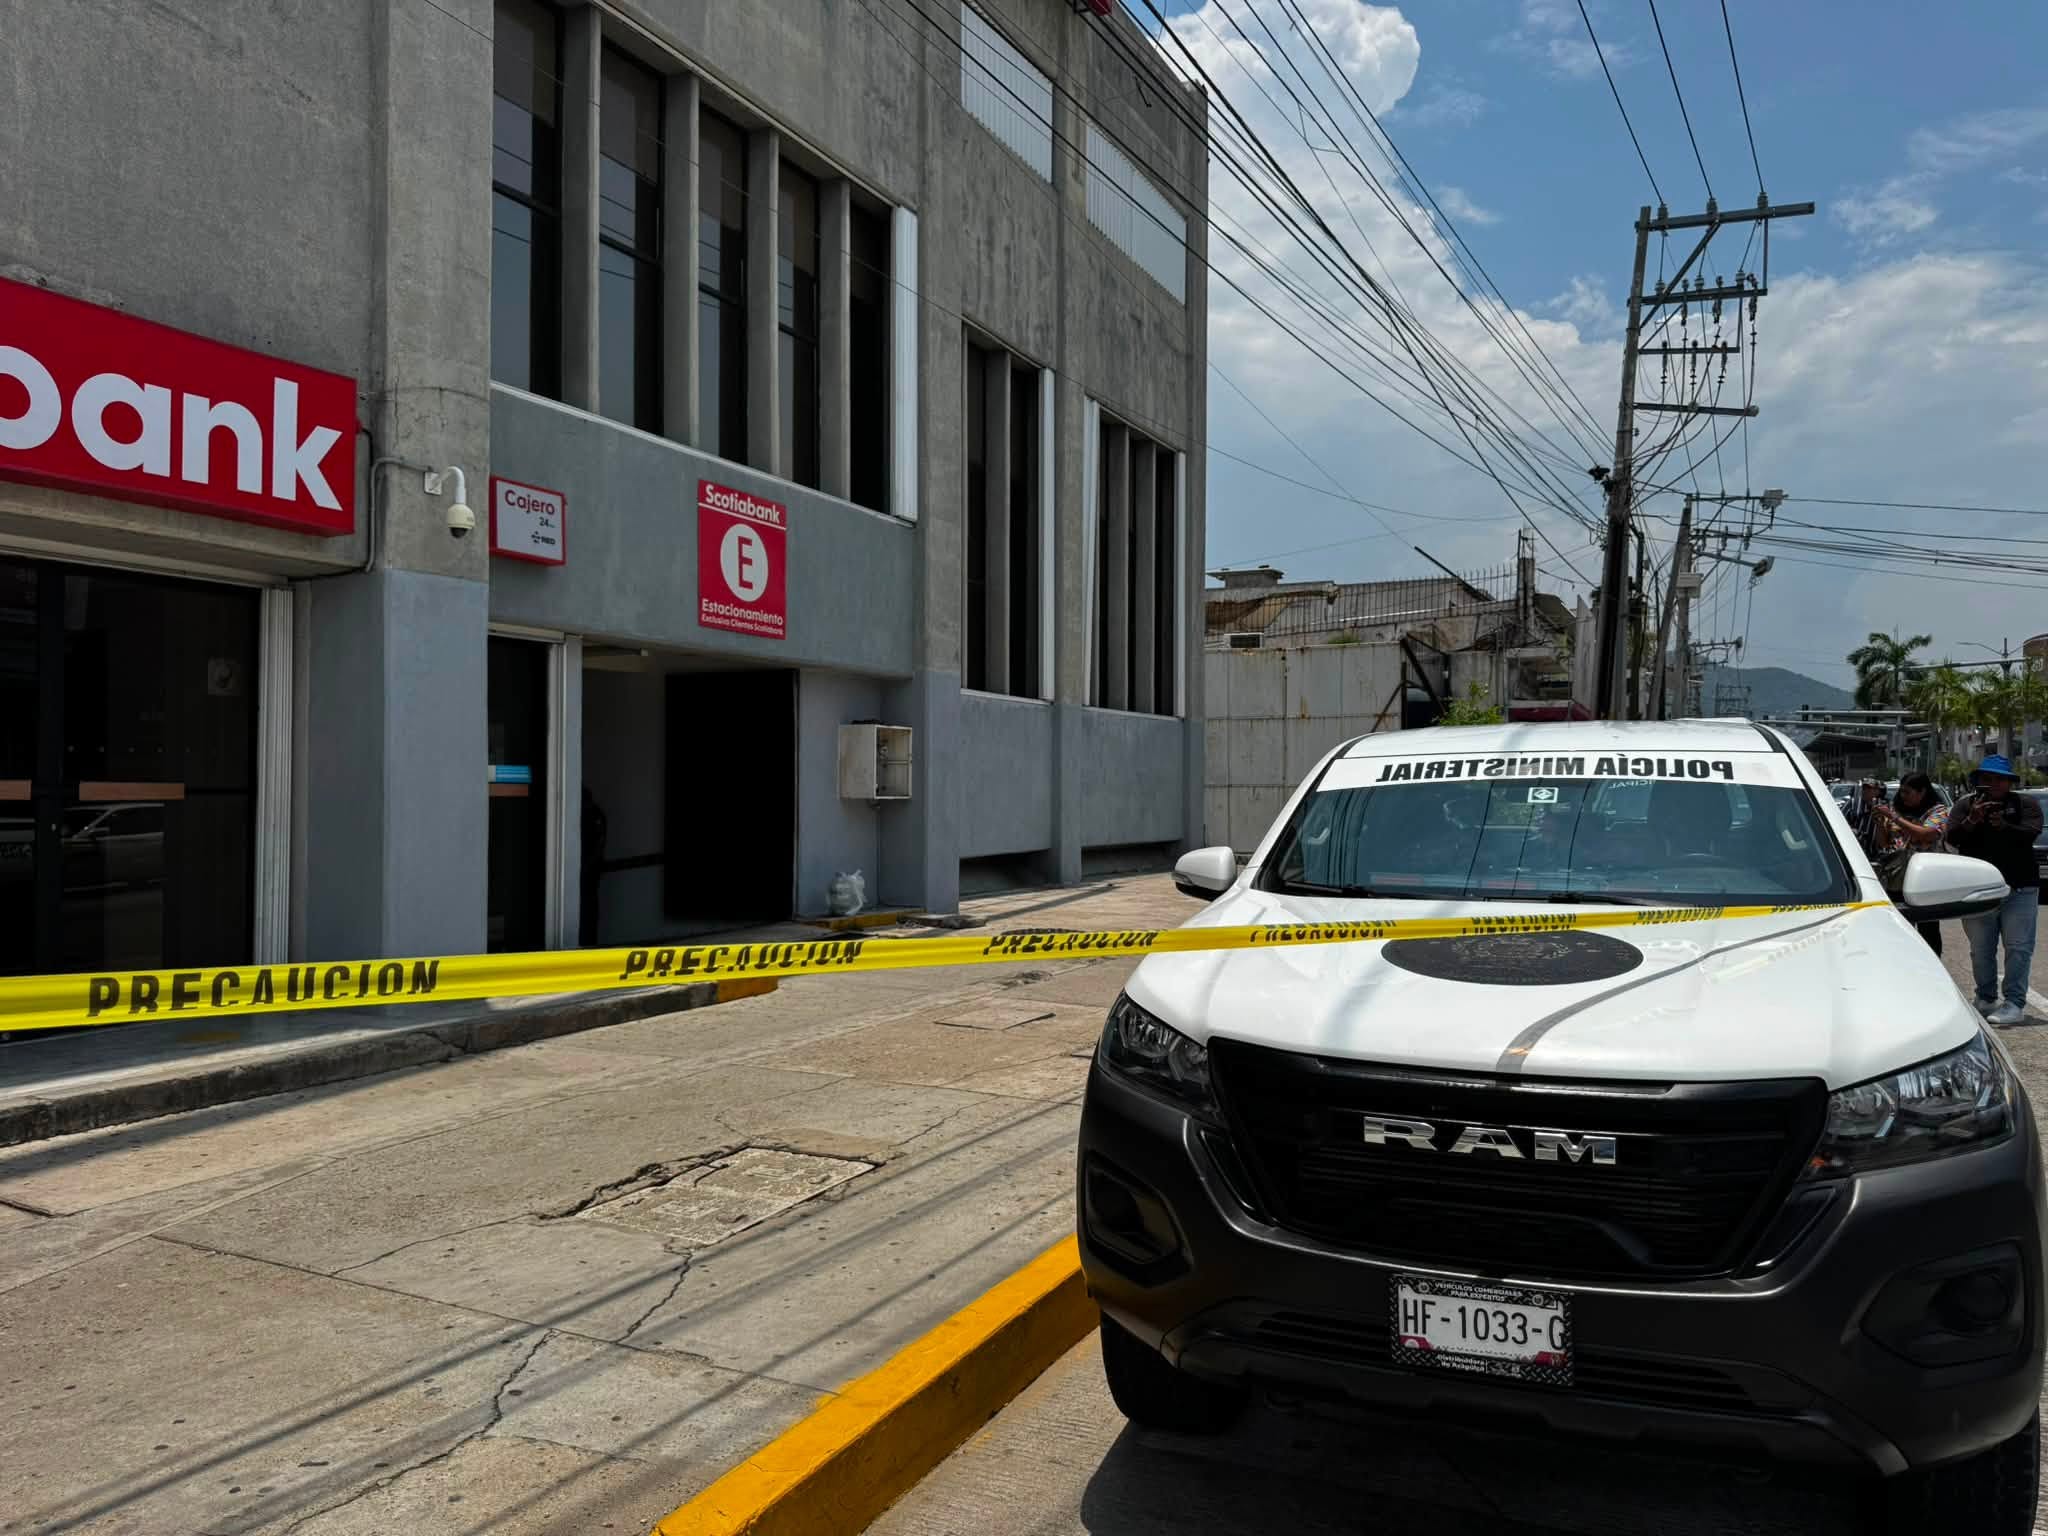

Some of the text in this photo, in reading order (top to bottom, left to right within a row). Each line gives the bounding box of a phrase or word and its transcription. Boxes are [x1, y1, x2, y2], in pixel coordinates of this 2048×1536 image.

[505, 489, 555, 515] Cajero
[705, 484, 780, 523] Scotiabank
[539, 516, 549, 527] 24
[738, 536, 753, 591] E
[702, 598, 783, 626] Estacionamiento
[731, 618, 754, 630] Clientes
[619, 942, 864, 980] PRECAUCION
[87, 960, 440, 1017] PRECAUCION
[1363, 1116, 1618, 1166] RAM
[1403, 1298, 1567, 1351] HF-1033-G
